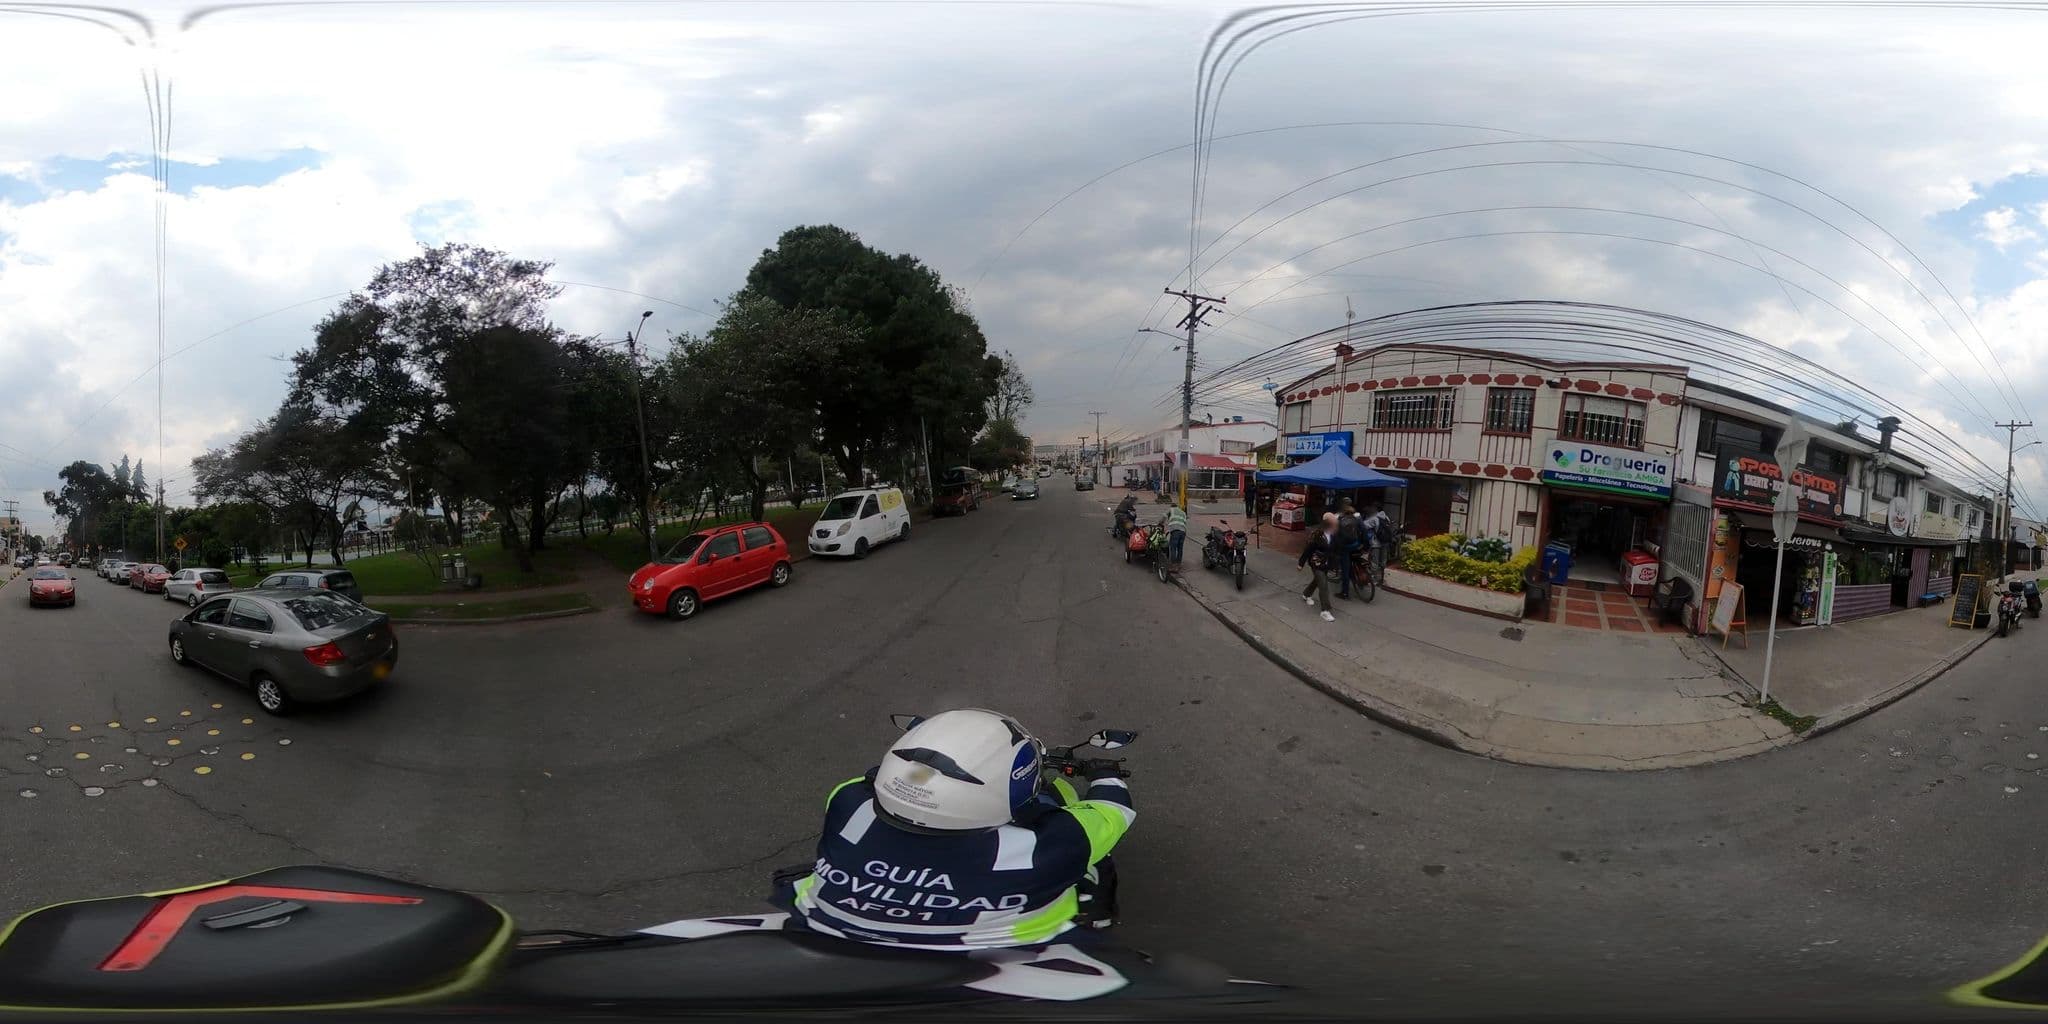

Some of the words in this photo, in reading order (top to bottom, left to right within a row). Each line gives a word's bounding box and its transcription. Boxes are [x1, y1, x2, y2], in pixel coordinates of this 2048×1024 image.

[1578, 464, 1591, 473] Su
[1634, 473, 1665, 484] AMIGA
[1580, 449, 1667, 475] Droguería
[1739, 457, 1782, 478] SPOR
[815, 857, 1029, 910] MOVILIDAD
[864, 859, 954, 890] GUÍA
